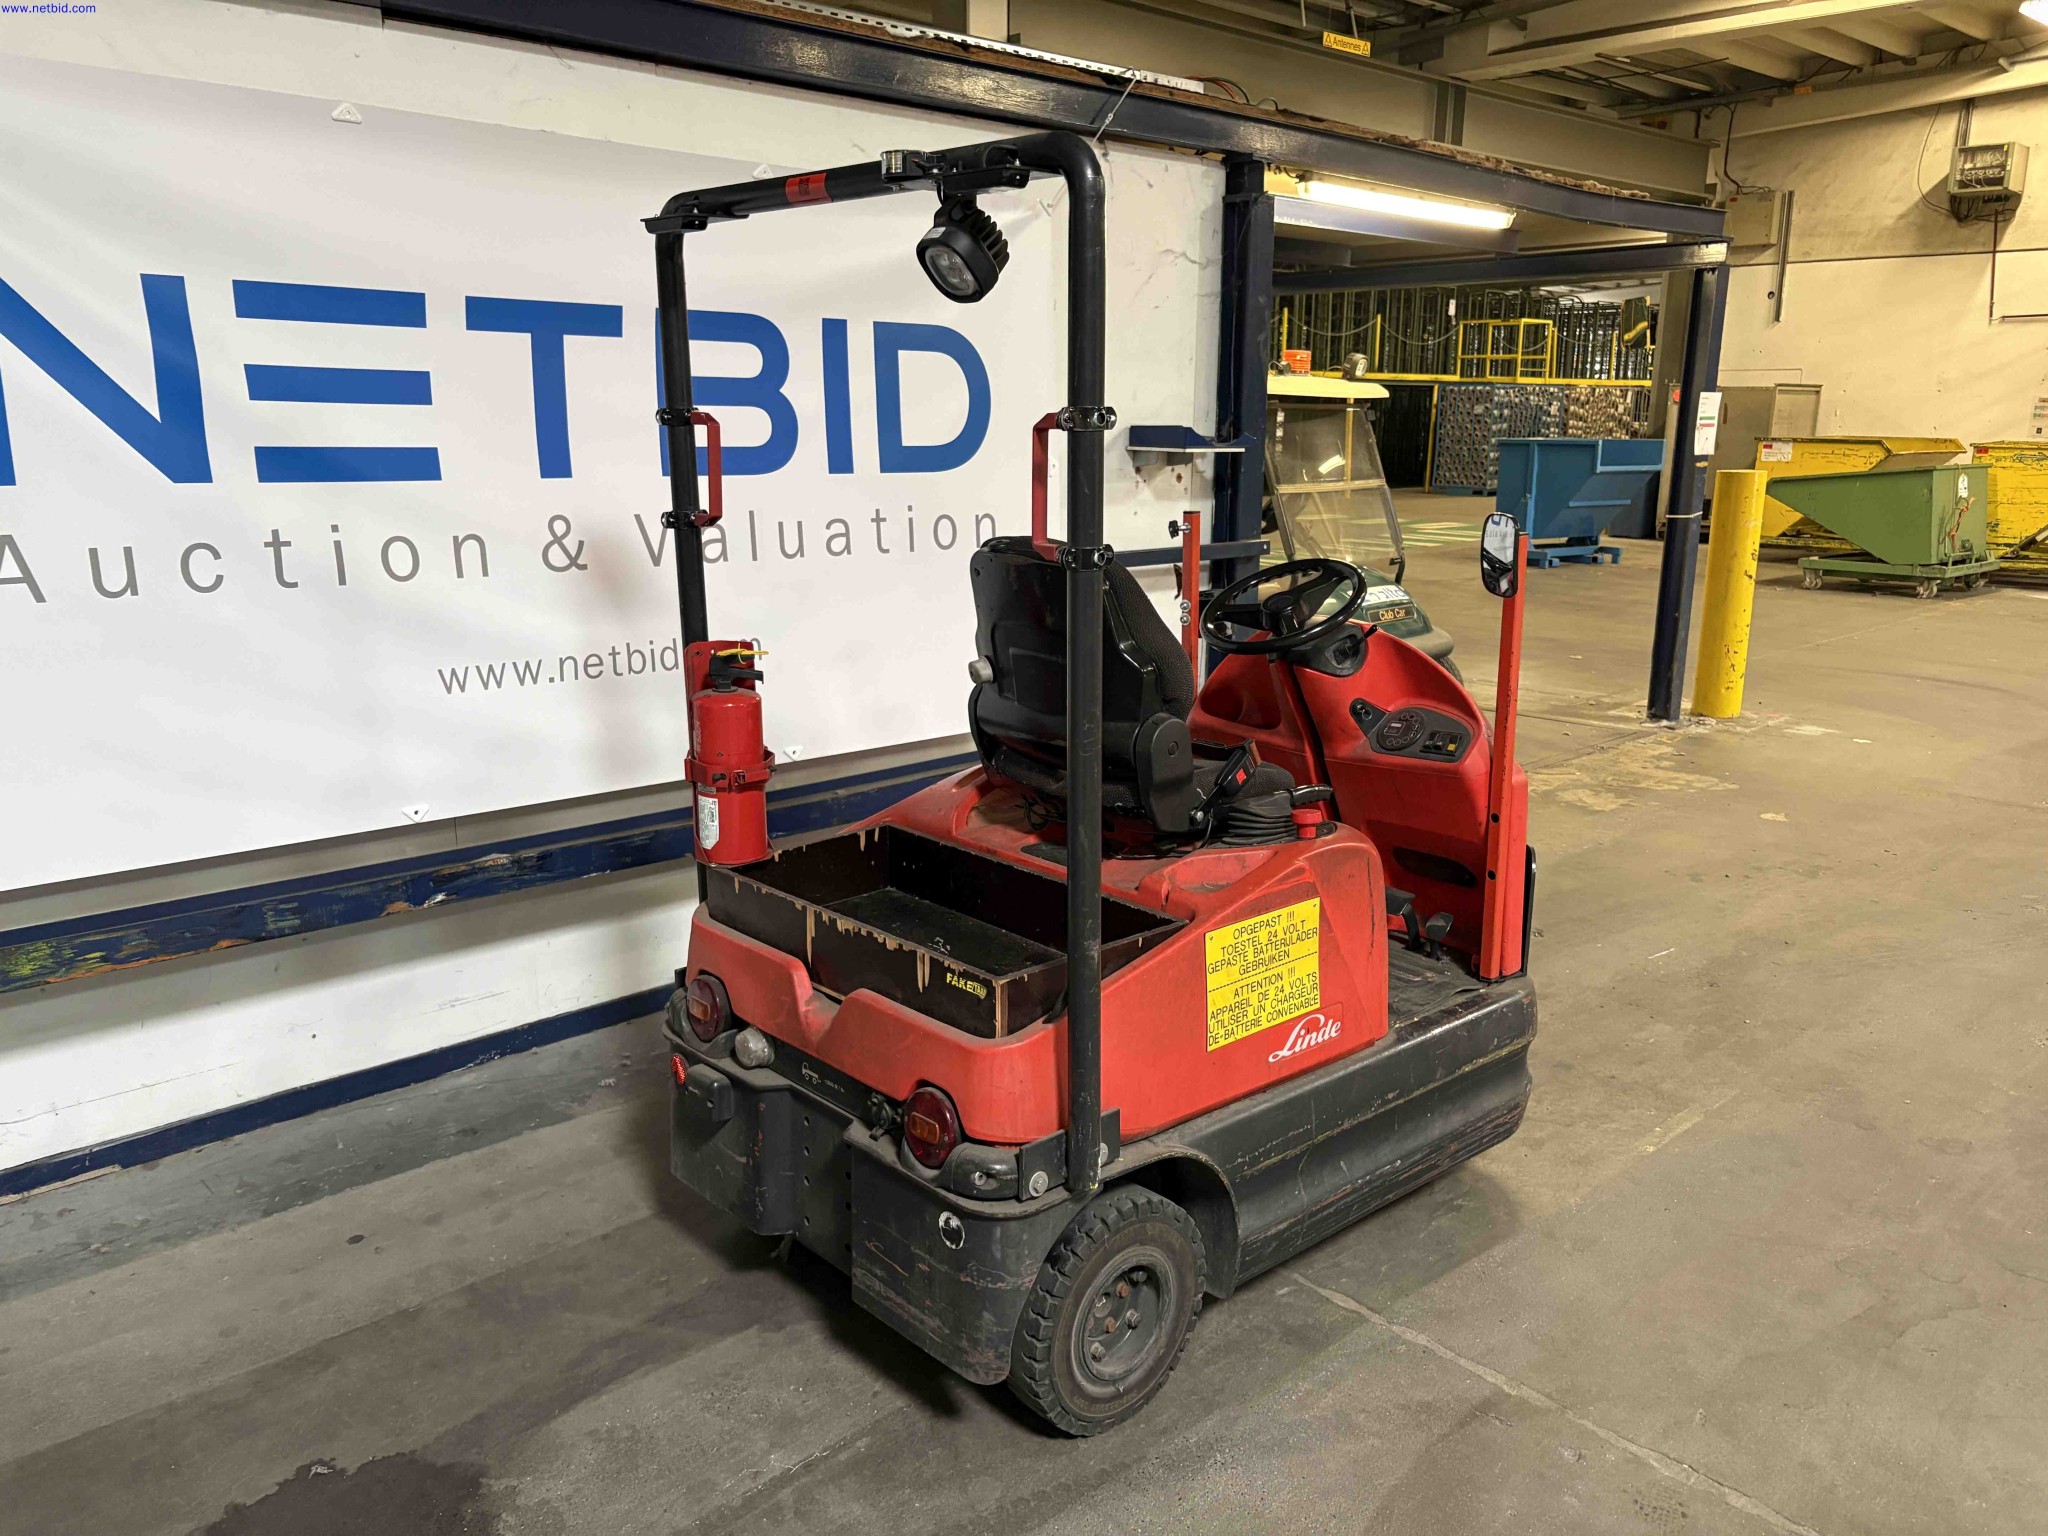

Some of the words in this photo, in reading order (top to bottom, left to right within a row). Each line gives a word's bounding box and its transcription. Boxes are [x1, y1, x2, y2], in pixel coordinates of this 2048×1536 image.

[0, 273, 992, 486] NETBID
[0, 524, 490, 604] Auction
[541, 514, 588, 573] &
[634, 505, 997, 567] Valuation
[1379, 609, 1394, 621] Club
[1394, 608, 1406, 618] Car
[438, 636, 763, 695] www.netbid
[1221, 935, 1263, 955] TOESTEL
[1267, 931, 1278, 942] 24
[1282, 920, 1306, 936] VOLT
[1233, 914, 1282, 940] OPGEPAST
[1286, 911, 1295, 923] !!!
[1207, 953, 1249, 975] GEPASTE
[1238, 949, 1290, 976] GEBRUIKEN
[1209, 997, 1253, 1022] APPAREIL
[1257, 990, 1270, 1003] DE
[1274, 986, 1285, 998] 24
[1289, 971, 1317, 990] VOLTS
[1233, 972, 1284, 999] ATTENTION
[1287, 966, 1296, 979] !!!
[1208, 1010, 1249, 1034] UTILISER
[1253, 1003, 1266, 1017] UN
[1270, 982, 1319, 1009] CHARGEUR
[1266, 994, 1319, 1023] CONVENABLE
[1268, 1013, 1341, 1063] Linde
